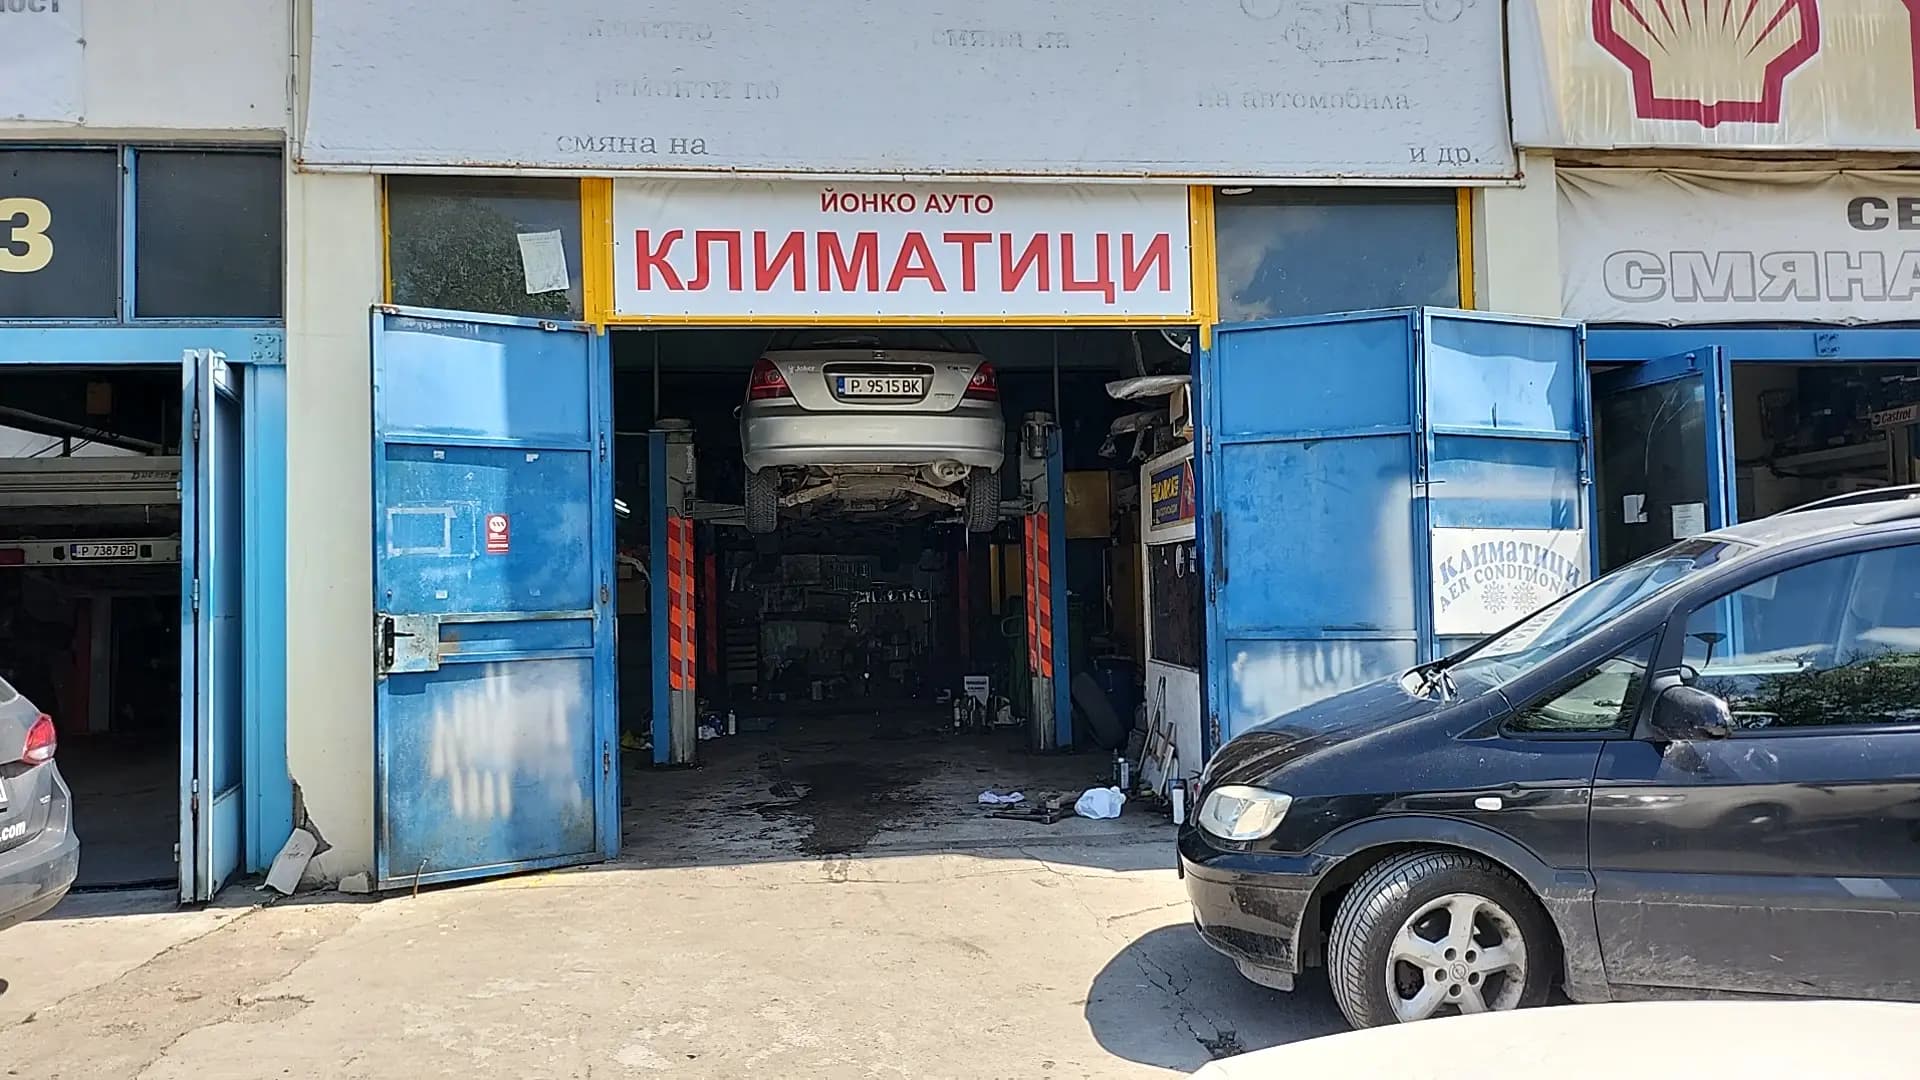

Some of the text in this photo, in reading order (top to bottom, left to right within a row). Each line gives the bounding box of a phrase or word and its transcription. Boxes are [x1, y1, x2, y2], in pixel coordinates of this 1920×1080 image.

[556, 135, 710, 155] смяна на
[1408, 146, 1480, 167] и др.
[820, 187, 995, 214] ЙОНКО АУТО
[634, 228, 1173, 304] КЛИМАТИЦИ
[867, 381, 900, 393] 9515
[903, 381, 920, 393] BK
[93, 546, 118, 556] 7387
[119, 545, 135, 556] BP
[1438, 576, 1471, 614] AER
